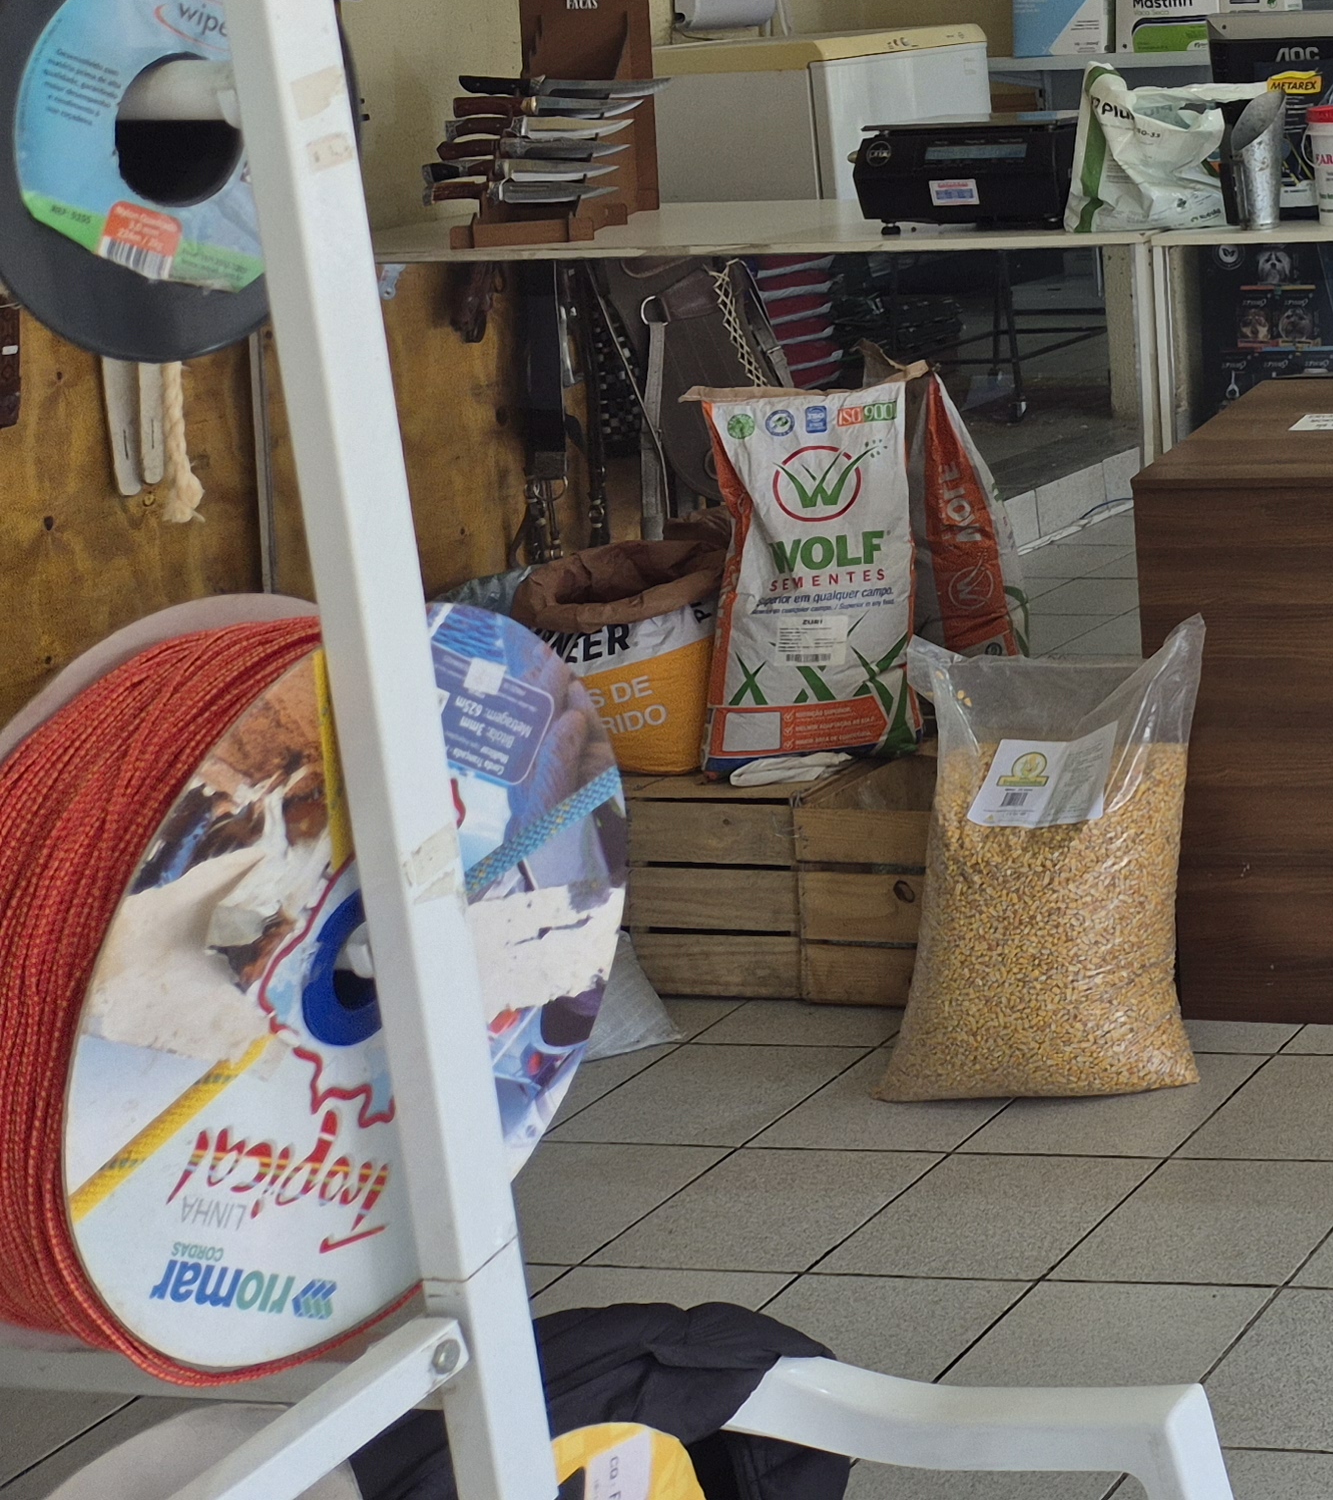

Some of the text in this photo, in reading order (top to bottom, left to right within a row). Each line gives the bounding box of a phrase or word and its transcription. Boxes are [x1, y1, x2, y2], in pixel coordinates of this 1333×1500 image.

[566, 0, 598, 9] FACAS
[1276, 47, 1320, 62] AOC
[1270, 81, 1317, 90] METAREX
[838, 409, 862, 426] ISO
[770, 530, 885, 574] WOLF
[769, 568, 886, 592] SEMENTES
[794, 586, 894, 604] em qualquer campo.
[611, 675, 653, 703] DE
[455, 696, 533, 738] Metragem: 625m
[600, 704, 667, 734] RIDO
[459, 716, 515, 748] Bitola: 3mm
[484, 759, 504, 775] Corda
[166, 1110, 390, 1254] Tropical
[181, 1195, 246, 1231] LINHA
[171, 1241, 223, 1261] CORDAS
[149, 1259, 296, 1315] riomar
